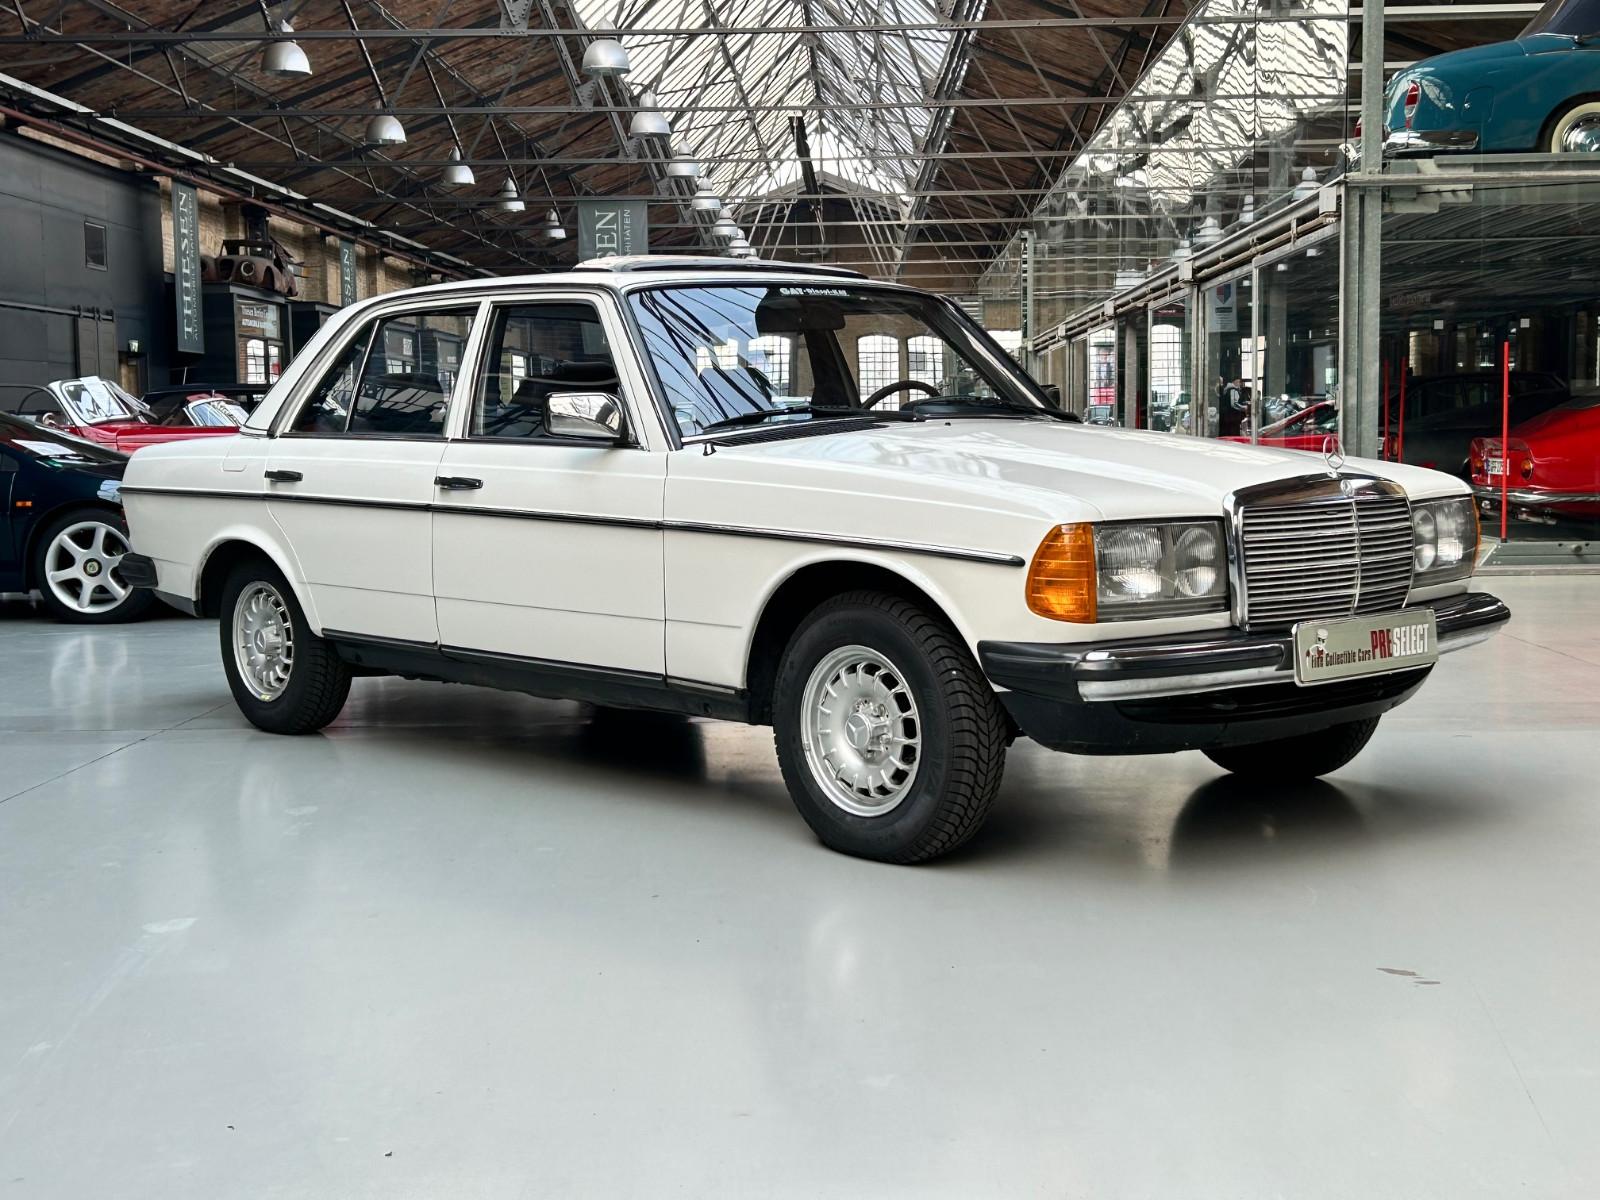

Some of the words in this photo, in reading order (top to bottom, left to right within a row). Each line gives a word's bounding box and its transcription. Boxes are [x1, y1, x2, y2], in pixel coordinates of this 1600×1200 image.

[178, 191, 193, 341] THIESEN
[1311, 654, 1323, 668] Fine
[1326, 651, 1356, 667] Collectible
[1358, 649, 1371, 662] Cars
